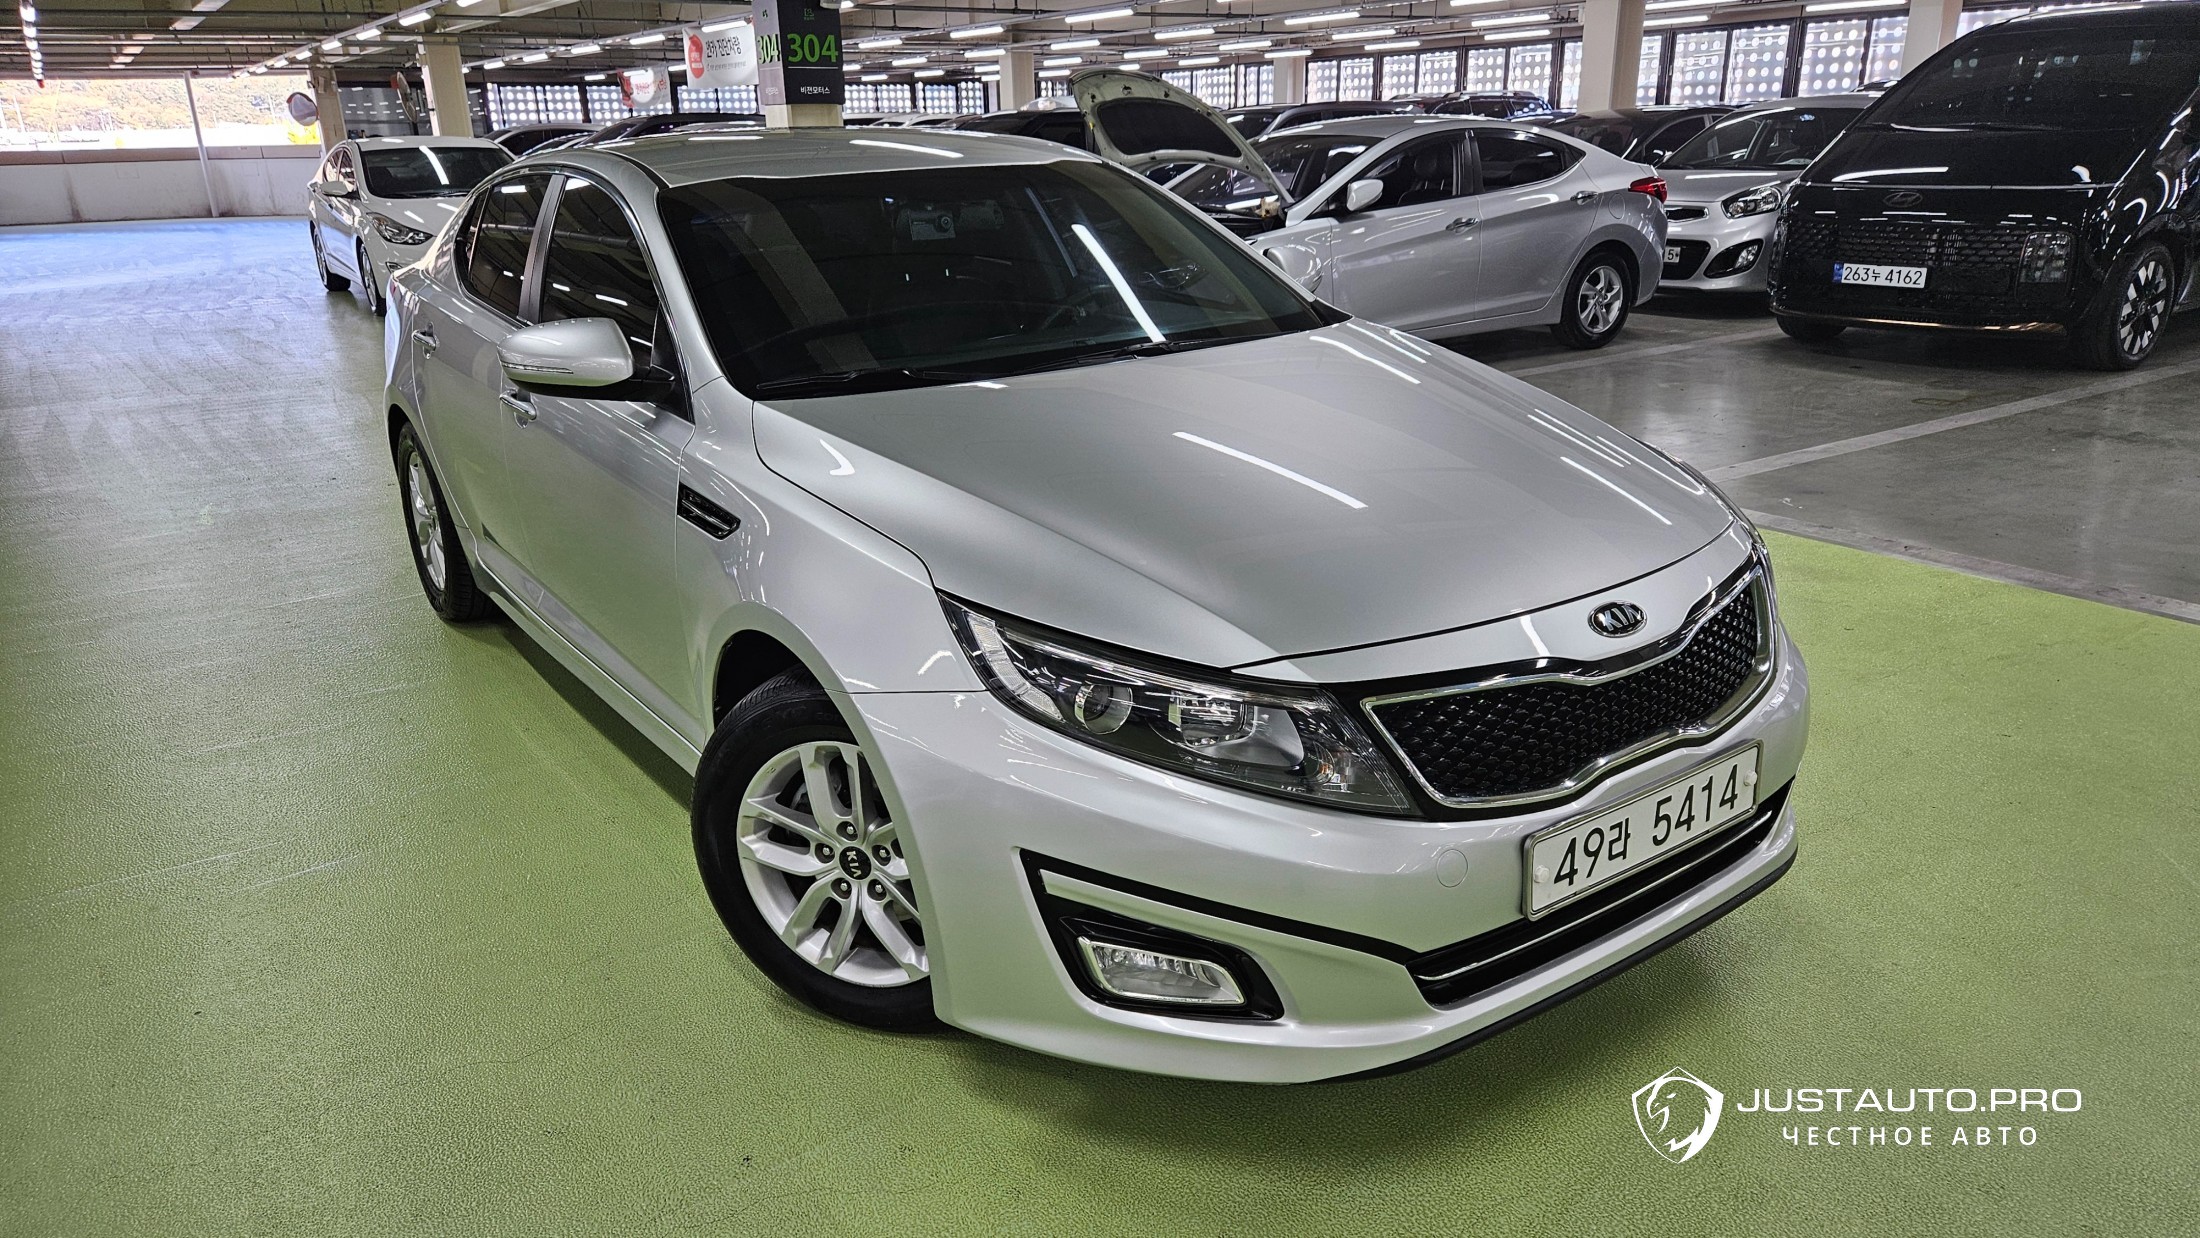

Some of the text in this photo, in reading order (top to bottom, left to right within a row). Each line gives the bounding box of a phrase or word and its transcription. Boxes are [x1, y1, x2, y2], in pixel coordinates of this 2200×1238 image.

[757, 33, 781, 64] 304
[787, 33, 839, 63] 304
[800, 86, 831, 95] 비전모터스
[1843, 266, 1881, 282] 263누
[1884, 269, 1923, 285] 4162
[1596, 604, 1643, 632] KIA
[1553, 763, 1738, 886] 49라 5414
[846, 850, 862, 878] KIA
